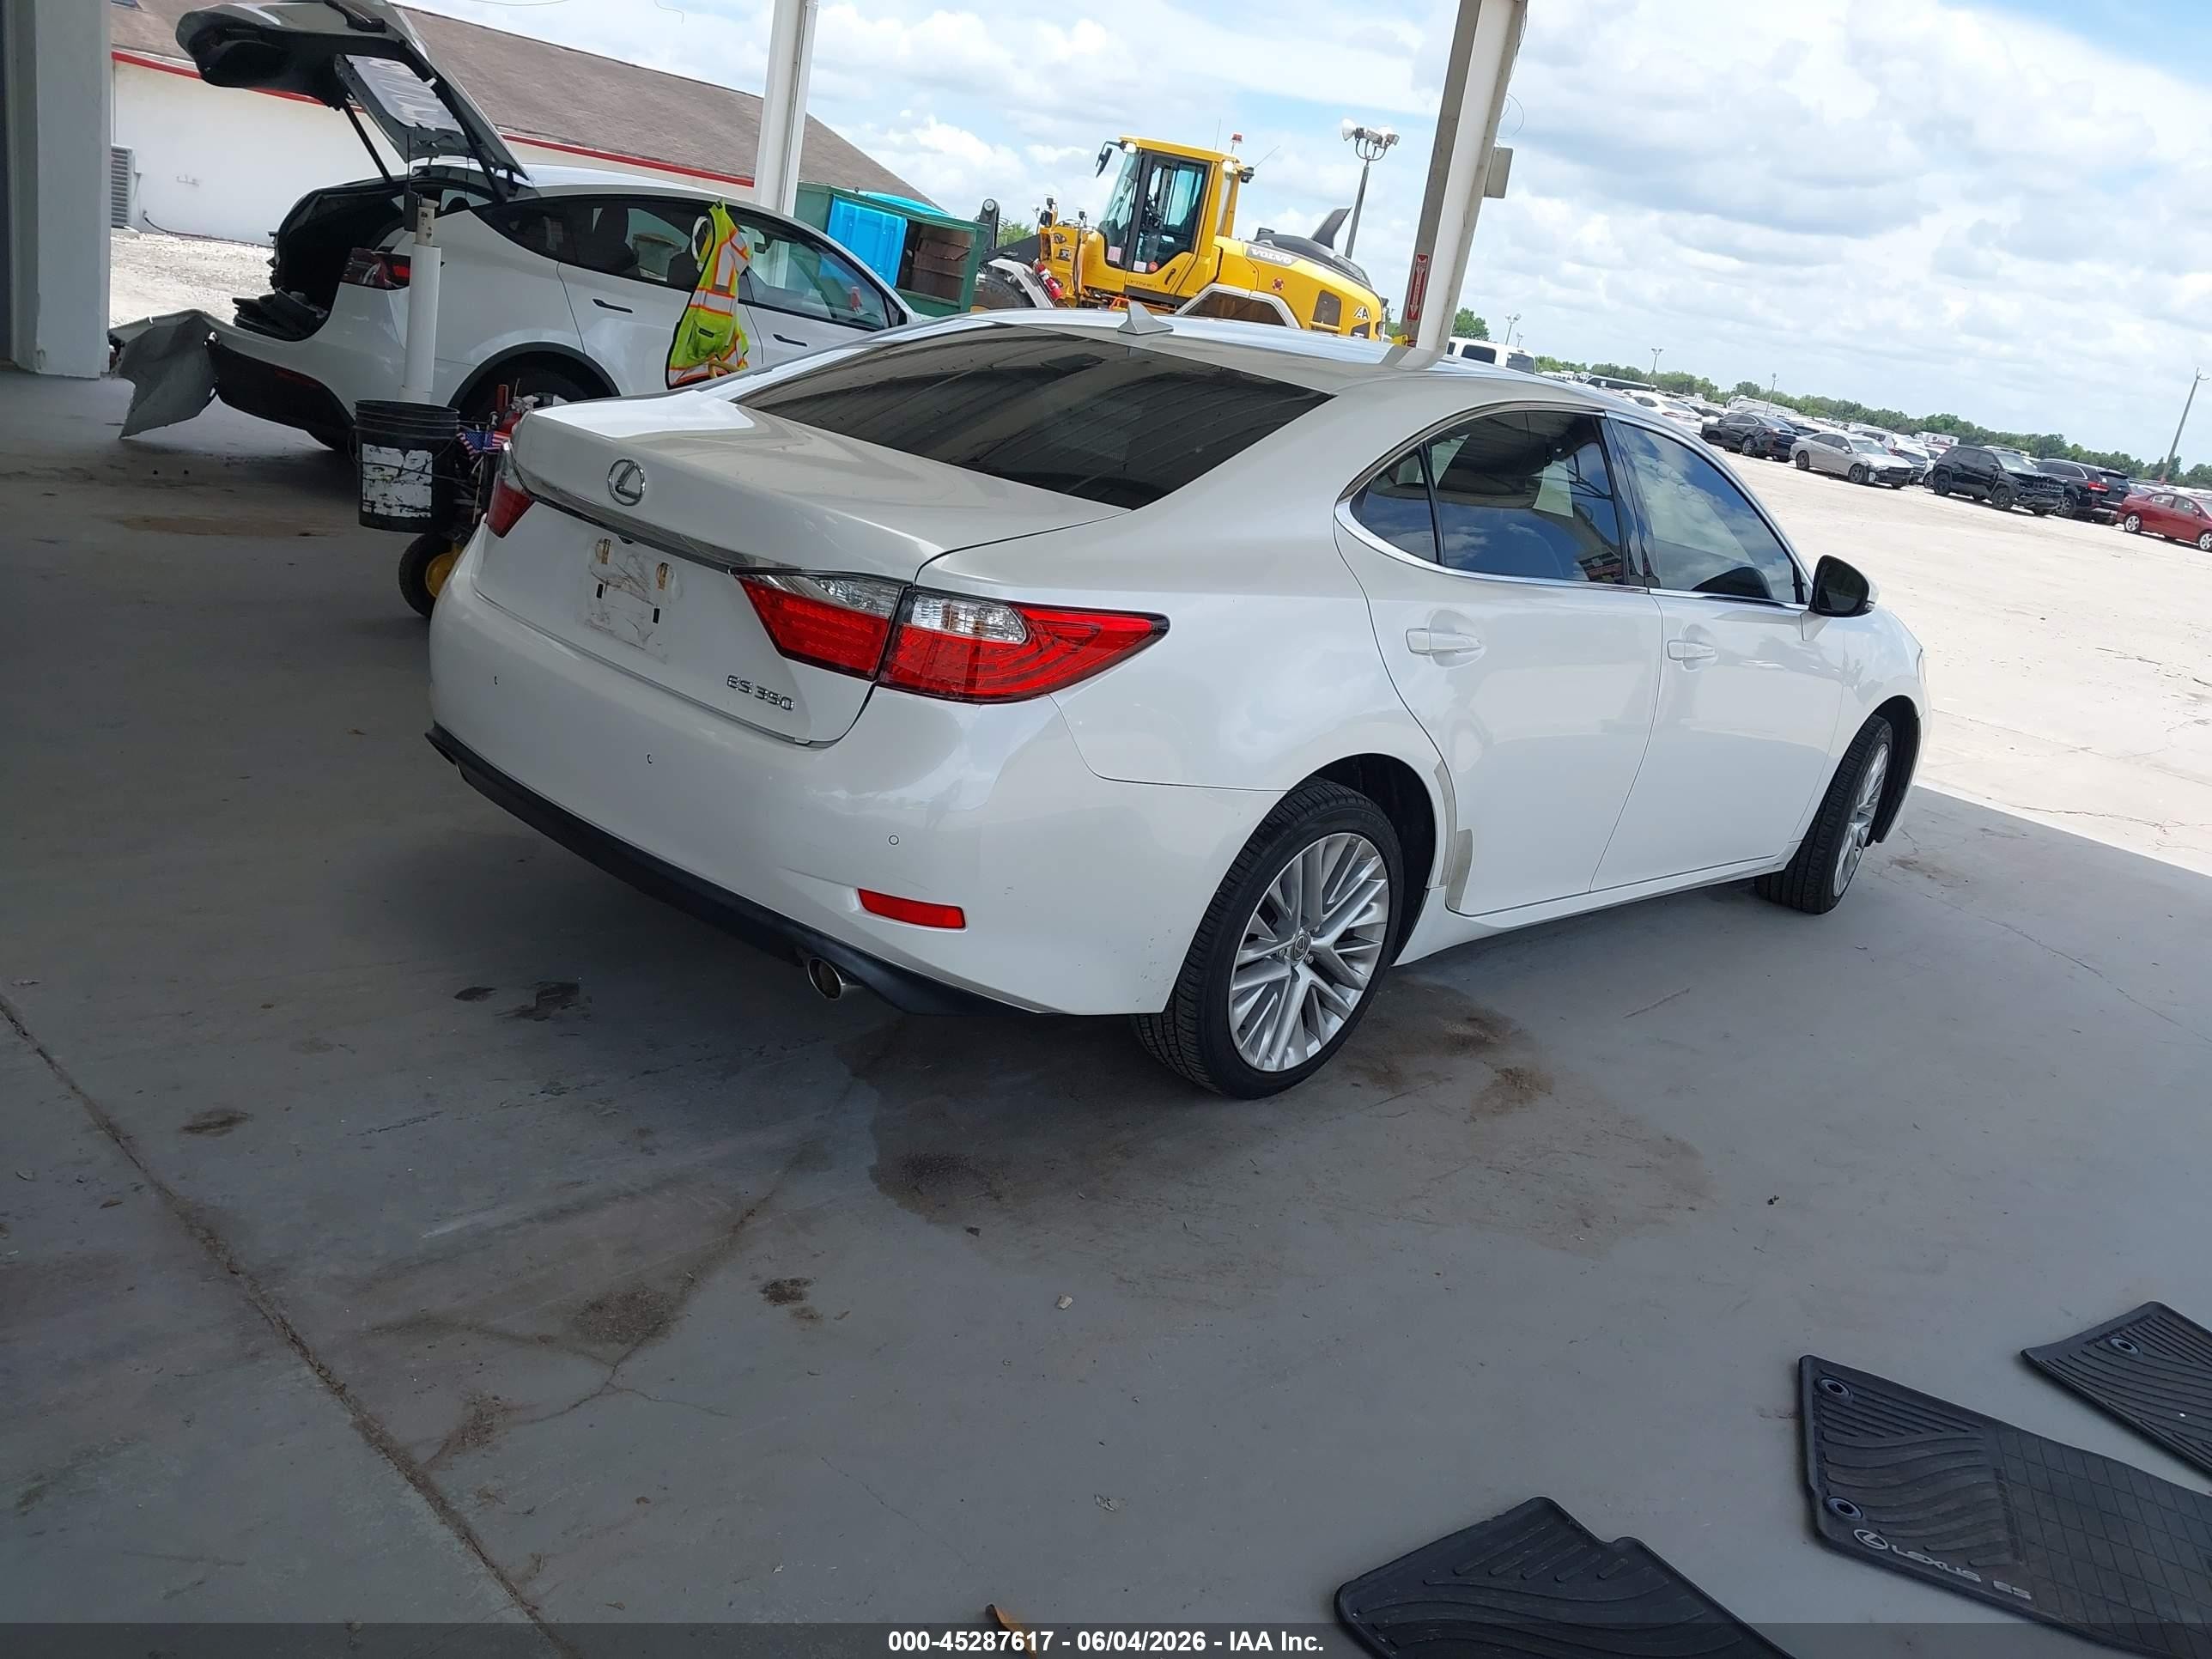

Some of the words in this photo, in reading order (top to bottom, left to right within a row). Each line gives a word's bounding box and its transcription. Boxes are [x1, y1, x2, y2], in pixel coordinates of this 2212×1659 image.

[1251, 248, 1292, 264] VOLVO
[727, 675, 753, 694] ES
[755, 685, 795, 711] 350
[1892, 1545, 1982, 1582] LEXUS
[1993, 1580, 2032, 1600] ES
